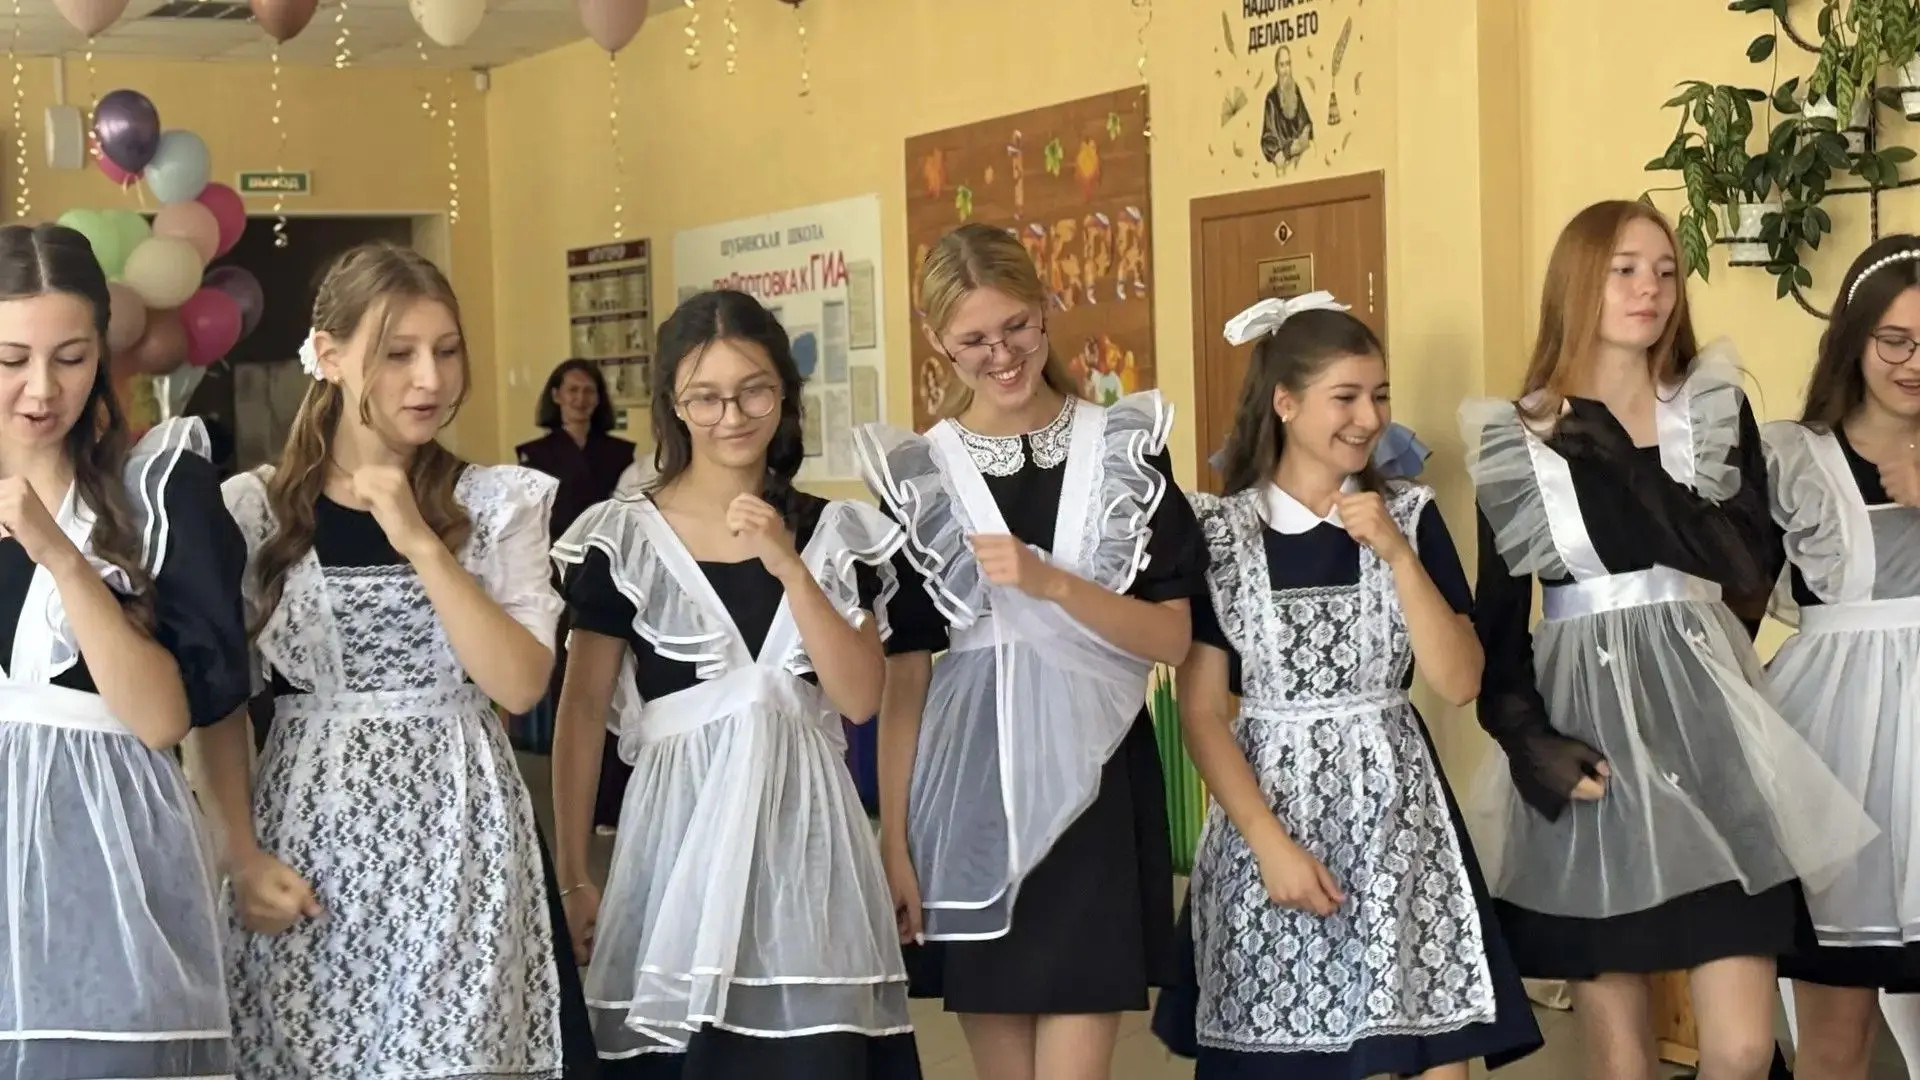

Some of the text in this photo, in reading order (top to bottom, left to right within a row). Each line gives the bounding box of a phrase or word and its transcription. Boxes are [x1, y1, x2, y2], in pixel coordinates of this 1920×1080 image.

[1247, 10, 1319, 55] ДЕЛАТЬ ЕГО
[787, 224, 824, 246] ШКОЛА
[810, 250, 849, 290] ГИА
